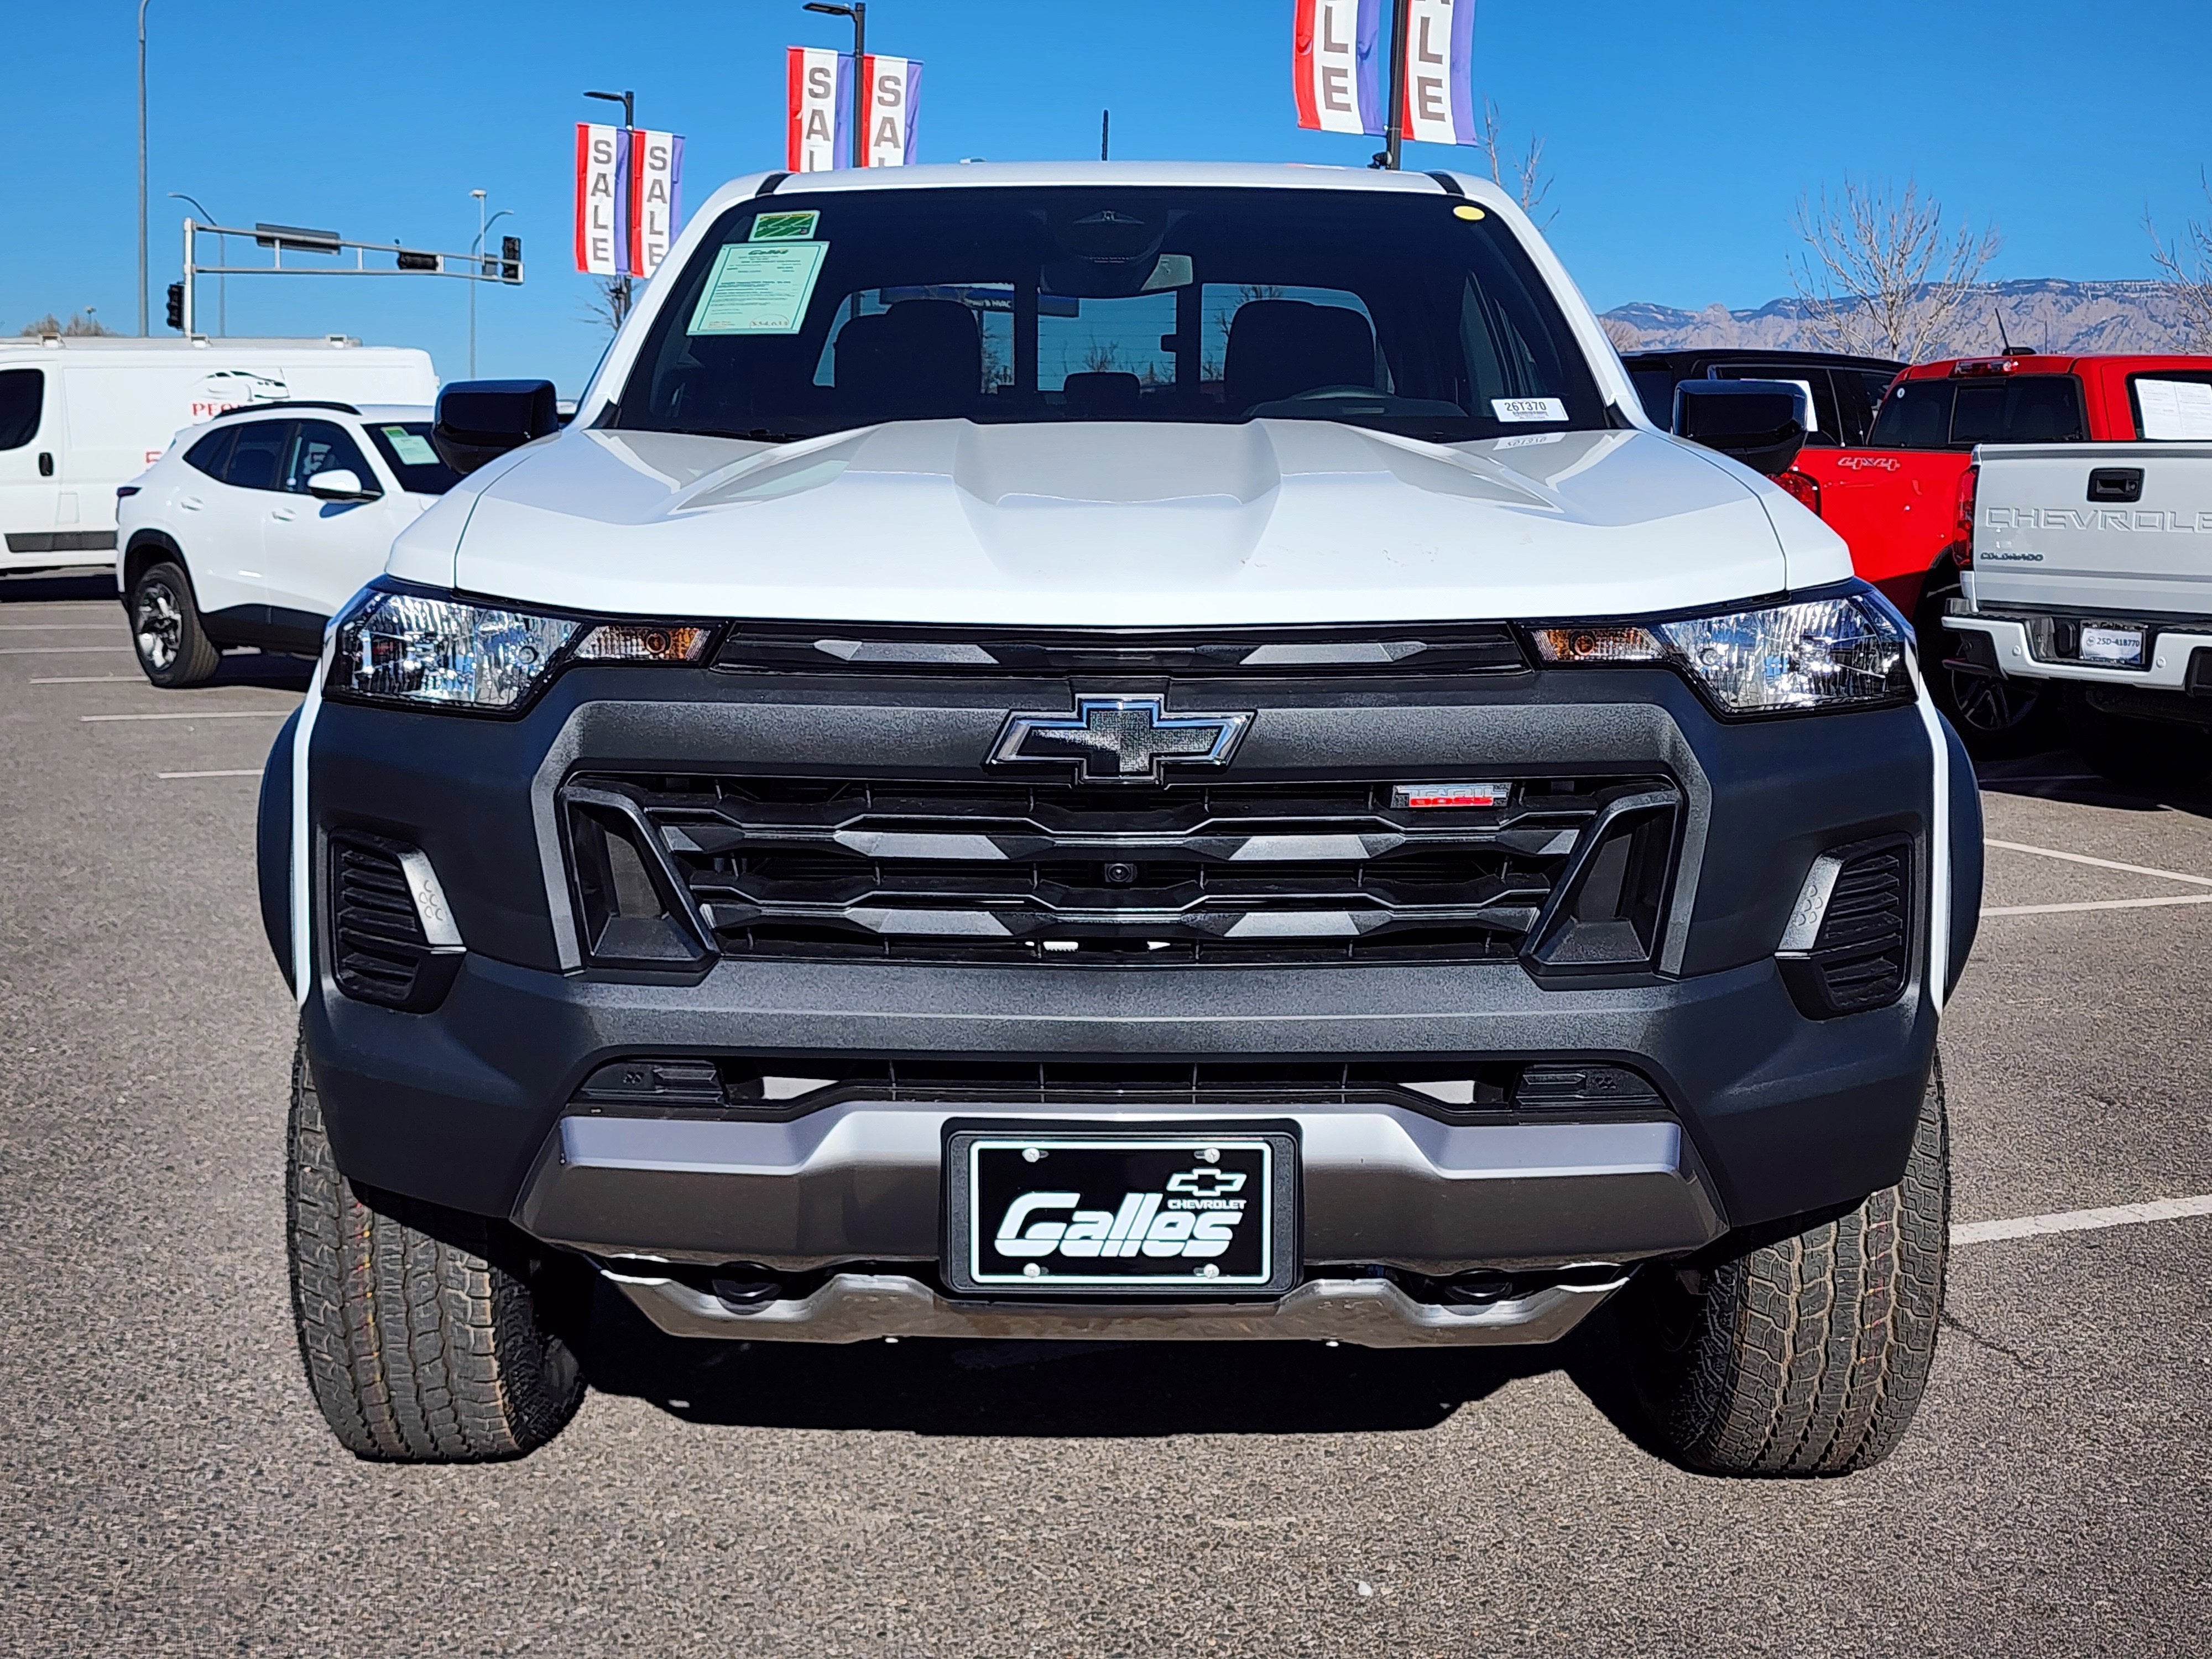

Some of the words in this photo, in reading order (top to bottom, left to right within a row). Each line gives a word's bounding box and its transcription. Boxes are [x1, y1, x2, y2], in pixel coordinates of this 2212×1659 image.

[1322, 0, 1352, 112] LE
[1417, 0, 1451, 122] LE
[873, 75, 901, 166] SA
[591, 139, 613, 262] SALE
[646, 146, 667, 266] SALE
[1504, 401, 1546, 411] 26T370
[1980, 552, 2044, 561] COLORADO
[1395, 786, 1507, 799] TRAIL
[1410, 797, 1493, 807] BOSS
[994, 1192, 1244, 1258] Galles
[1167, 1199, 1247, 1210] CHEVROLET
